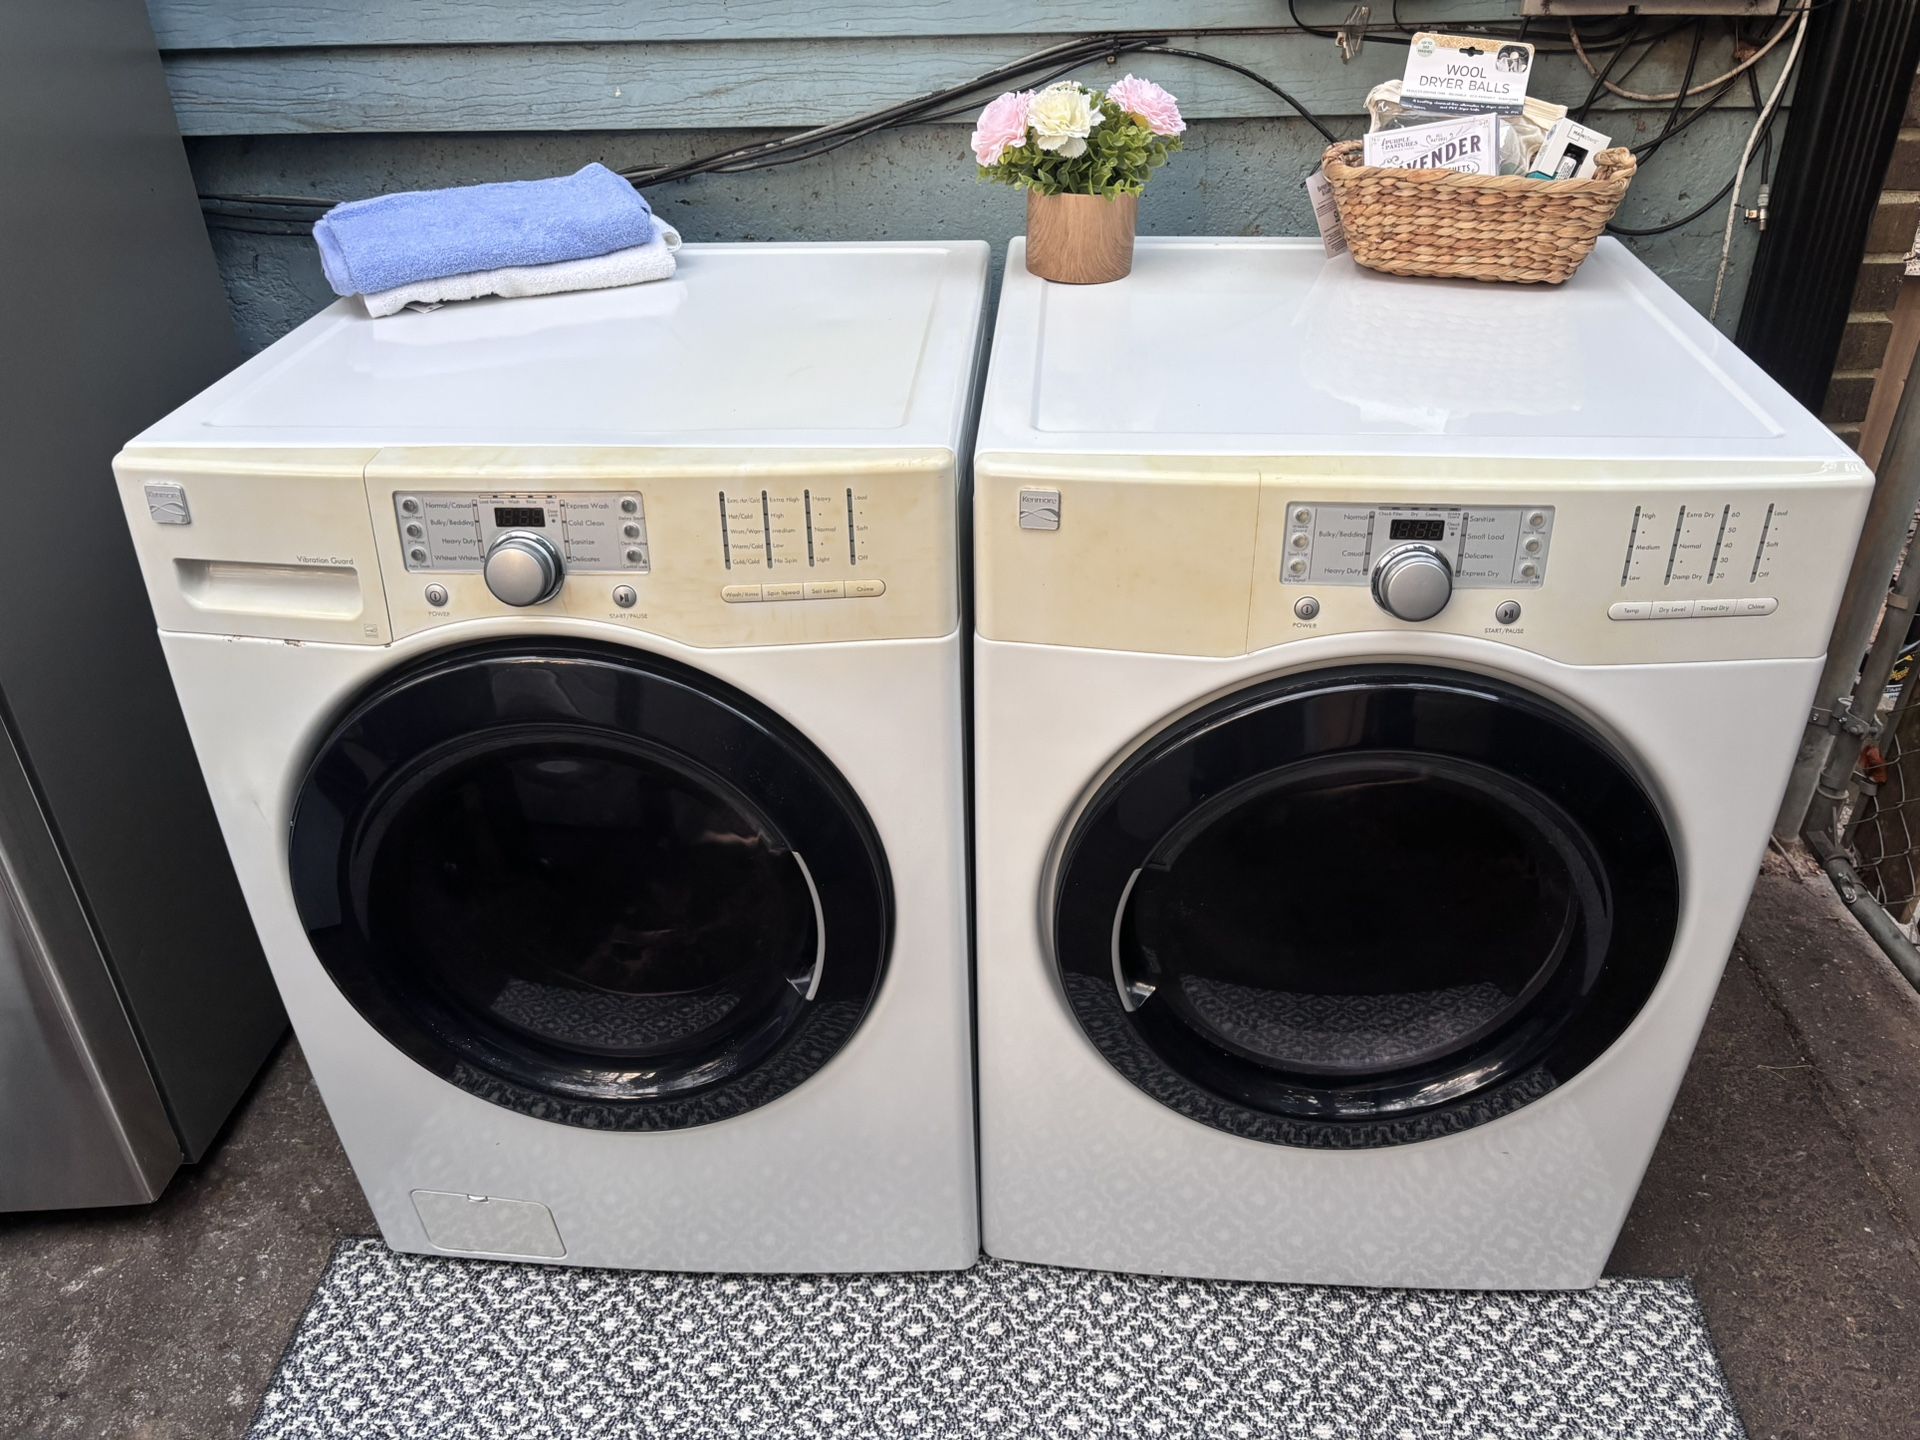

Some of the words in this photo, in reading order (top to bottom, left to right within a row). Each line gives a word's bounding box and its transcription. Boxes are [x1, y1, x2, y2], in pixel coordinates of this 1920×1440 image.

[1447, 64, 1487, 79] WOOL
[1419, 75, 1463, 90] DRYER
[1468, 81, 1510, 94] BALLS
[1400, 134, 1481, 170] VENDER
[1022, 495, 1057, 504] Kenmore
[1469, 515, 1496, 523] Sanitize
[1641, 512, 1656, 520] High
[1319, 531, 1366, 539] Bulky/Bedding
[462, 538, 476, 546] Duty
[296, 555, 329, 564] Vibration
[330, 556, 354, 565] Guard
[1346, 568, 1361, 576] Duty
[1487, 570, 1499, 578] Dry
[1658, 606, 1670, 614] Dry
